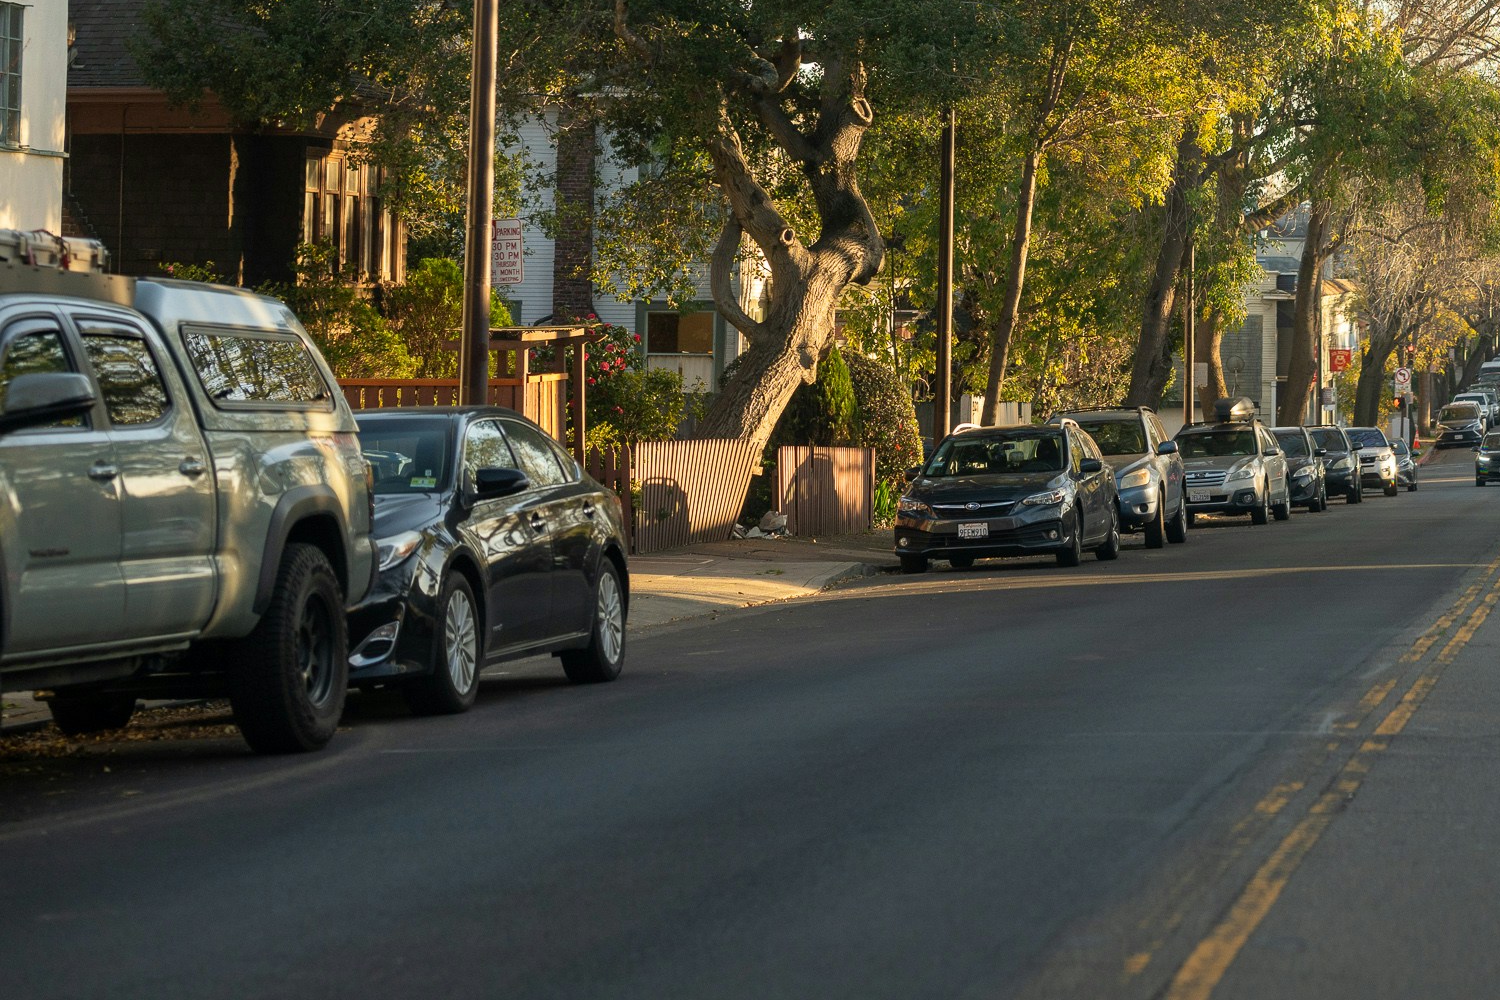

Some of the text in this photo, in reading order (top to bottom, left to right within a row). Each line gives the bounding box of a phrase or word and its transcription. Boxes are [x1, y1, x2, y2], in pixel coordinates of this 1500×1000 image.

[496, 227, 520, 237] PARKING
[505, 242, 517, 251] PM
[508, 251, 520, 260] PM
[496, 260, 517, 268] THURSDAY
